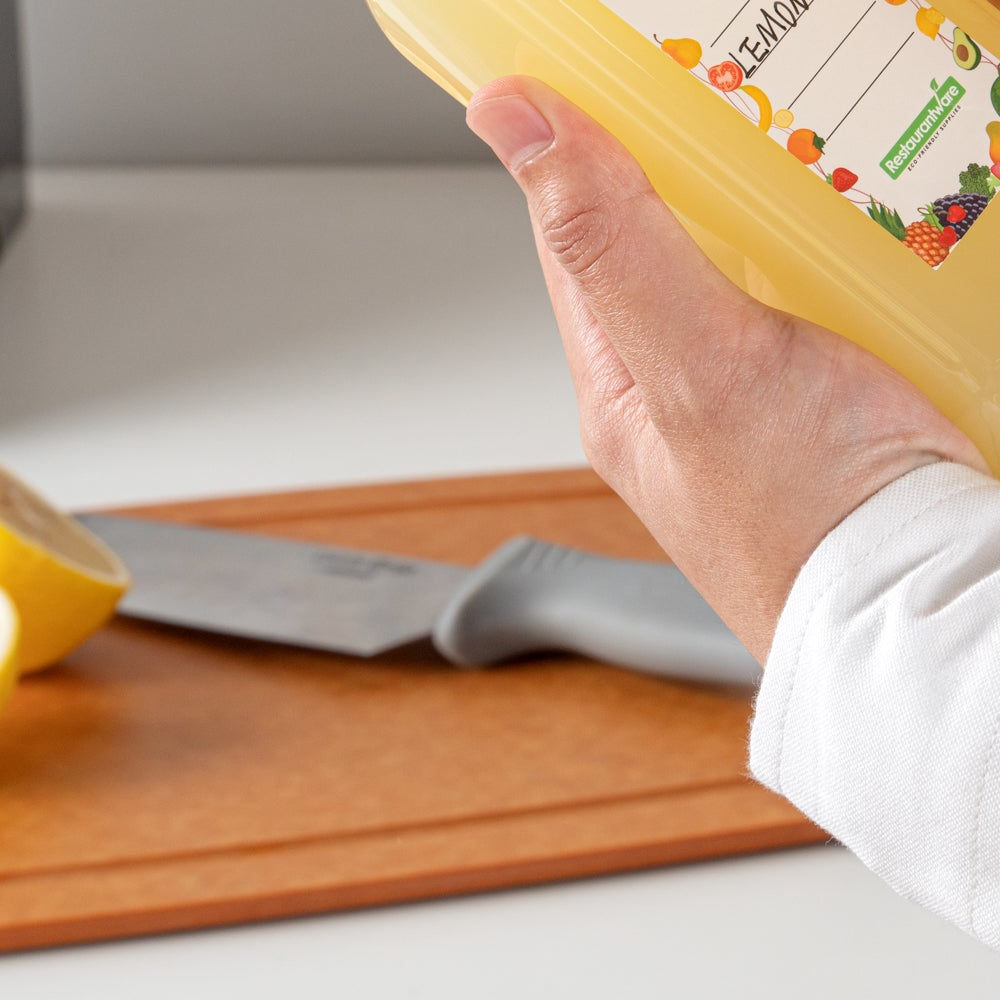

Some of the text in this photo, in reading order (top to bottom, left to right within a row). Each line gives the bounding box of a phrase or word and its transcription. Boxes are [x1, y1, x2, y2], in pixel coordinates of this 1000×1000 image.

[885, 85, 959, 174] Restaurantware
[907, 105, 962, 172] ECO-FRIENDLY SUPPLIES
